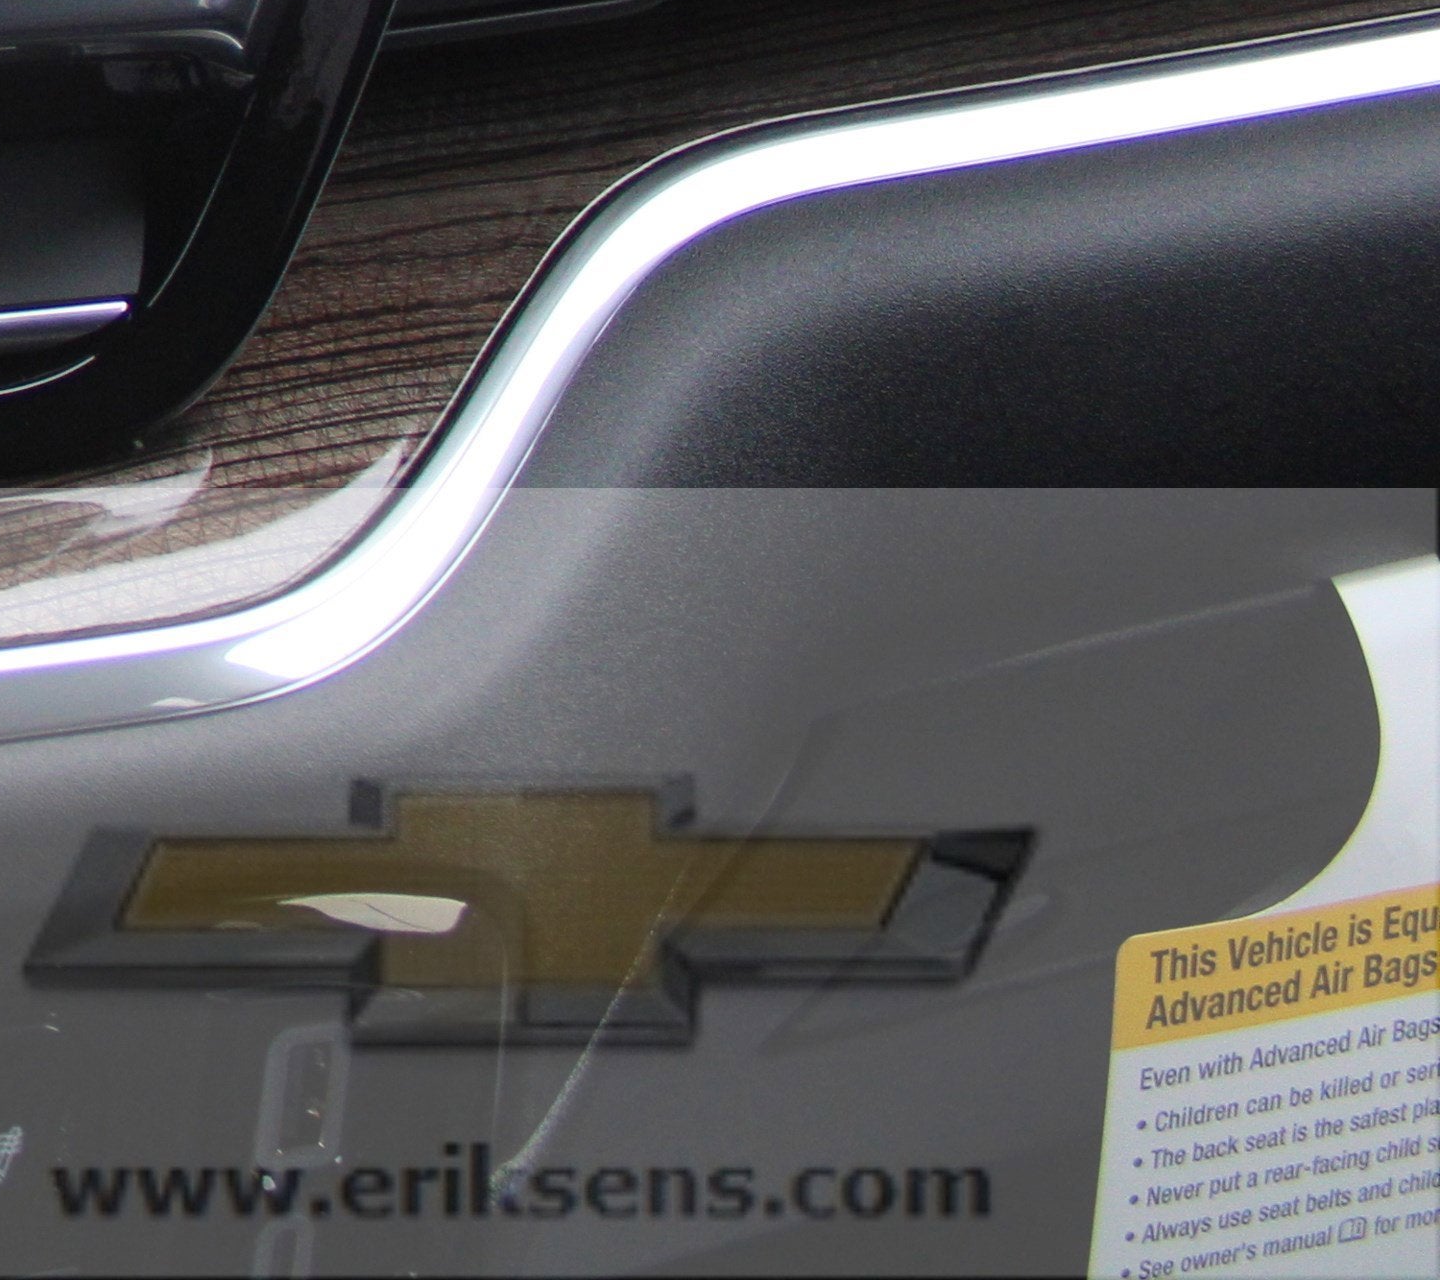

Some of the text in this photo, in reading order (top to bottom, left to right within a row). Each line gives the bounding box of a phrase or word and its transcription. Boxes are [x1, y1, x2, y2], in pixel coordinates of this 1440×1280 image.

[1151, 943, 1217, 983] This
[1228, 921, 1337, 970] Vehicle
[1347, 913, 1372, 947] is
[1145, 950, 1438, 1030] Advanced Air Bags
[1140, 1061, 1190, 1090] Even
[1198, 1051, 1243, 1079] with
[1249, 1030, 1352, 1070] Advanced
[1357, 1024, 1386, 1049] Air
[1155, 1101, 1239, 1132] Children
[1246, 1092, 1281, 1115] can
[1289, 1086, 1313, 1107] be
[1320, 1070, 1374, 1100] killed
[1380, 1069, 1401, 1089] or
[1151, 1146, 1185, 1170] The
[1192, 1134, 1238, 1161] back
[1244, 1126, 1286, 1152] seat
[1292, 1122, 1308, 1142] is
[1314, 1117, 1344, 1138] the
[1350, 1103, 1408, 1132] safest
[1146, 1180, 1203, 1207] Never
[1209, 1169, 1240, 1197] put
[1246, 1171, 1258, 1187] a
[1264, 1148, 1371, 1184] rear-facing
[1376, 1135, 1422, 1163] child
[1142, 1215, 1212, 1244] Always
[1218, 1210, 1253, 1229] use
[1258, 1196, 1300, 1220] seat
[1306, 1188, 1352, 1213] belts
[1357, 1176, 1393, 1203] and
[1138, 1258, 1174, 1280] See
[1180, 1242, 1256, 1272] owner's
[1262, 1225, 1333, 1256] manual
[1375, 1214, 1400, 1235] for
